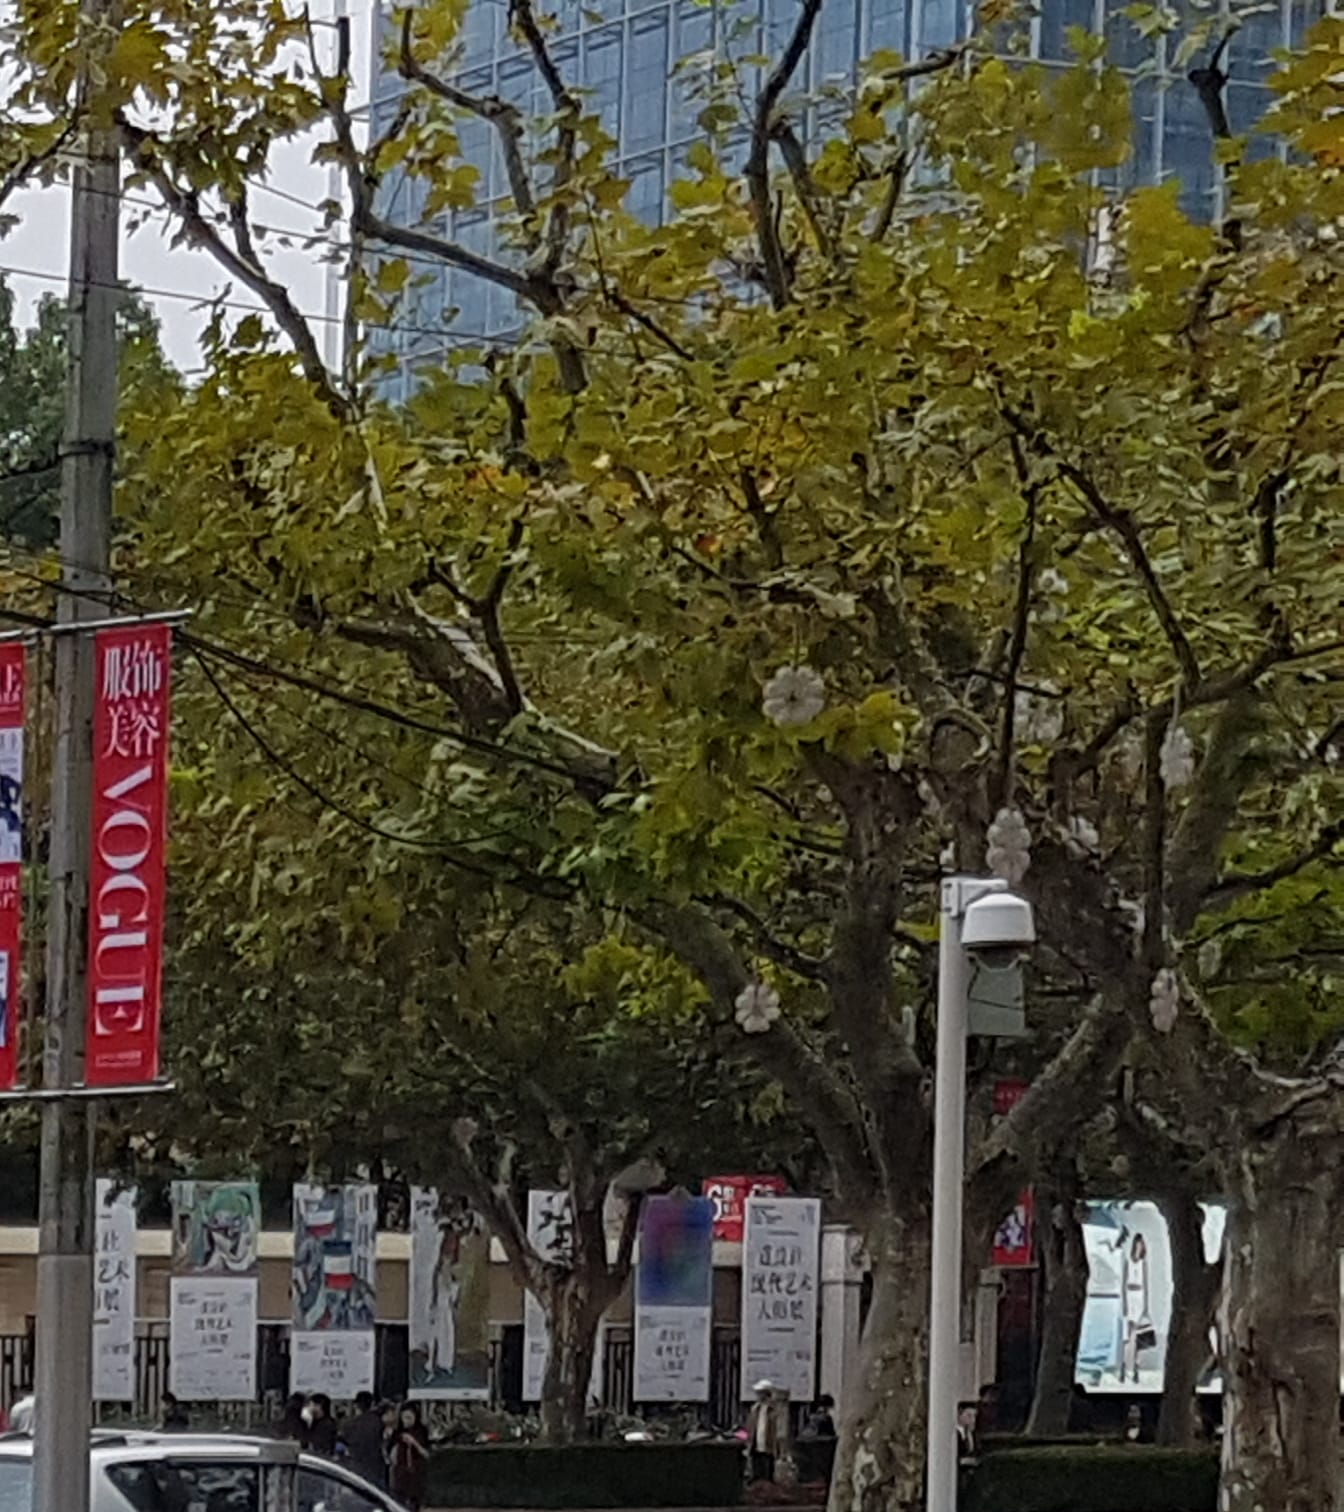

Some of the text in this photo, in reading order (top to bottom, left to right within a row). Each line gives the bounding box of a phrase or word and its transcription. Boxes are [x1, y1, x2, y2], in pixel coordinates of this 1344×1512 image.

[102, 640, 162, 701] 服饰
[101, 701, 161, 757] 美容
[95, 765, 153, 1035] VOGUE
